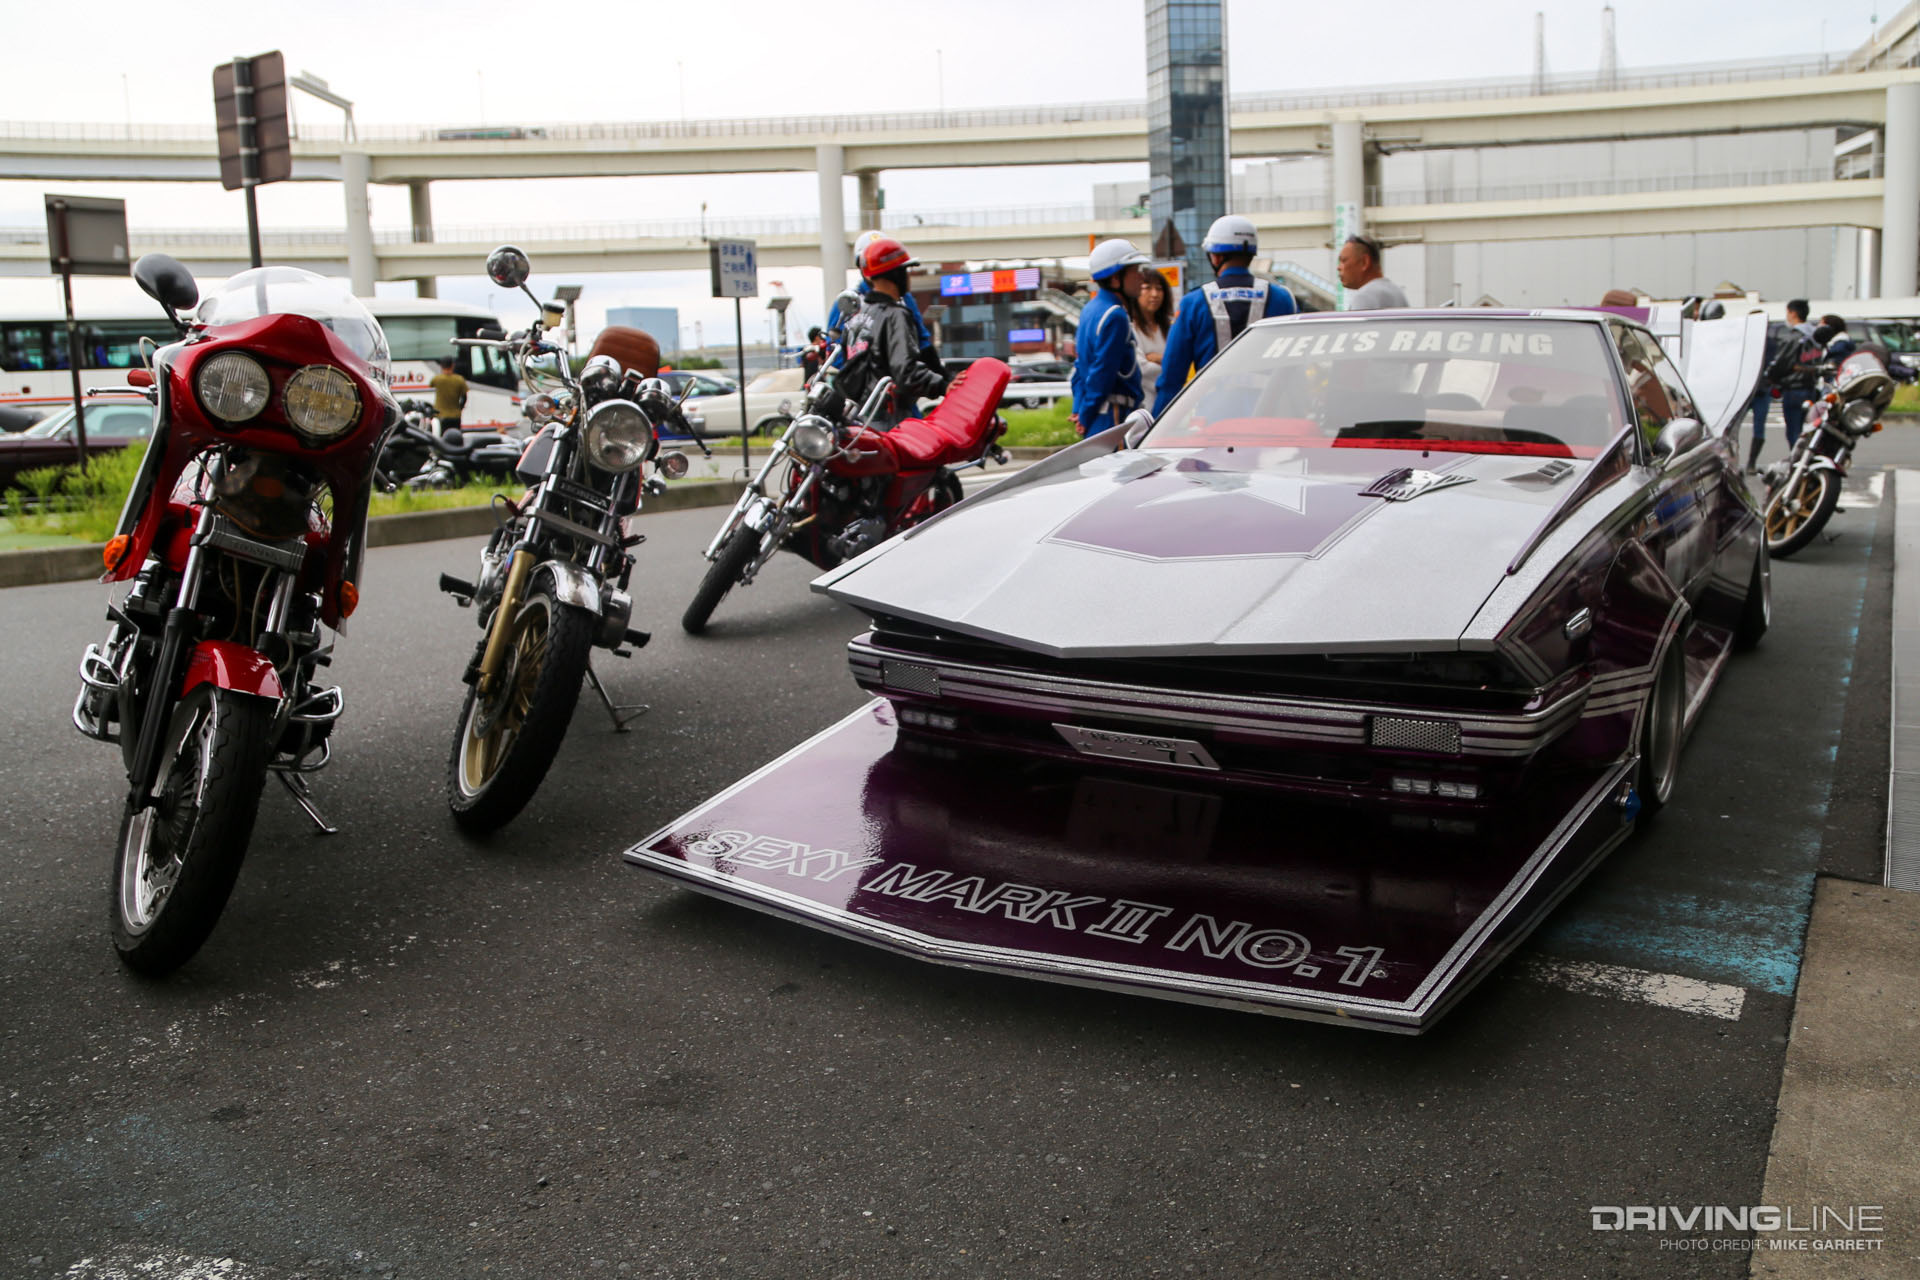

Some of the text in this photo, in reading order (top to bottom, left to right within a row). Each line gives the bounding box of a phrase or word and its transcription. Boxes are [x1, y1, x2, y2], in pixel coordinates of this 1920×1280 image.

[1262, 330, 1553, 359] HELL'S RACING
[688, 829, 886, 883] SEXY
[863, 862, 1106, 931] MARK
